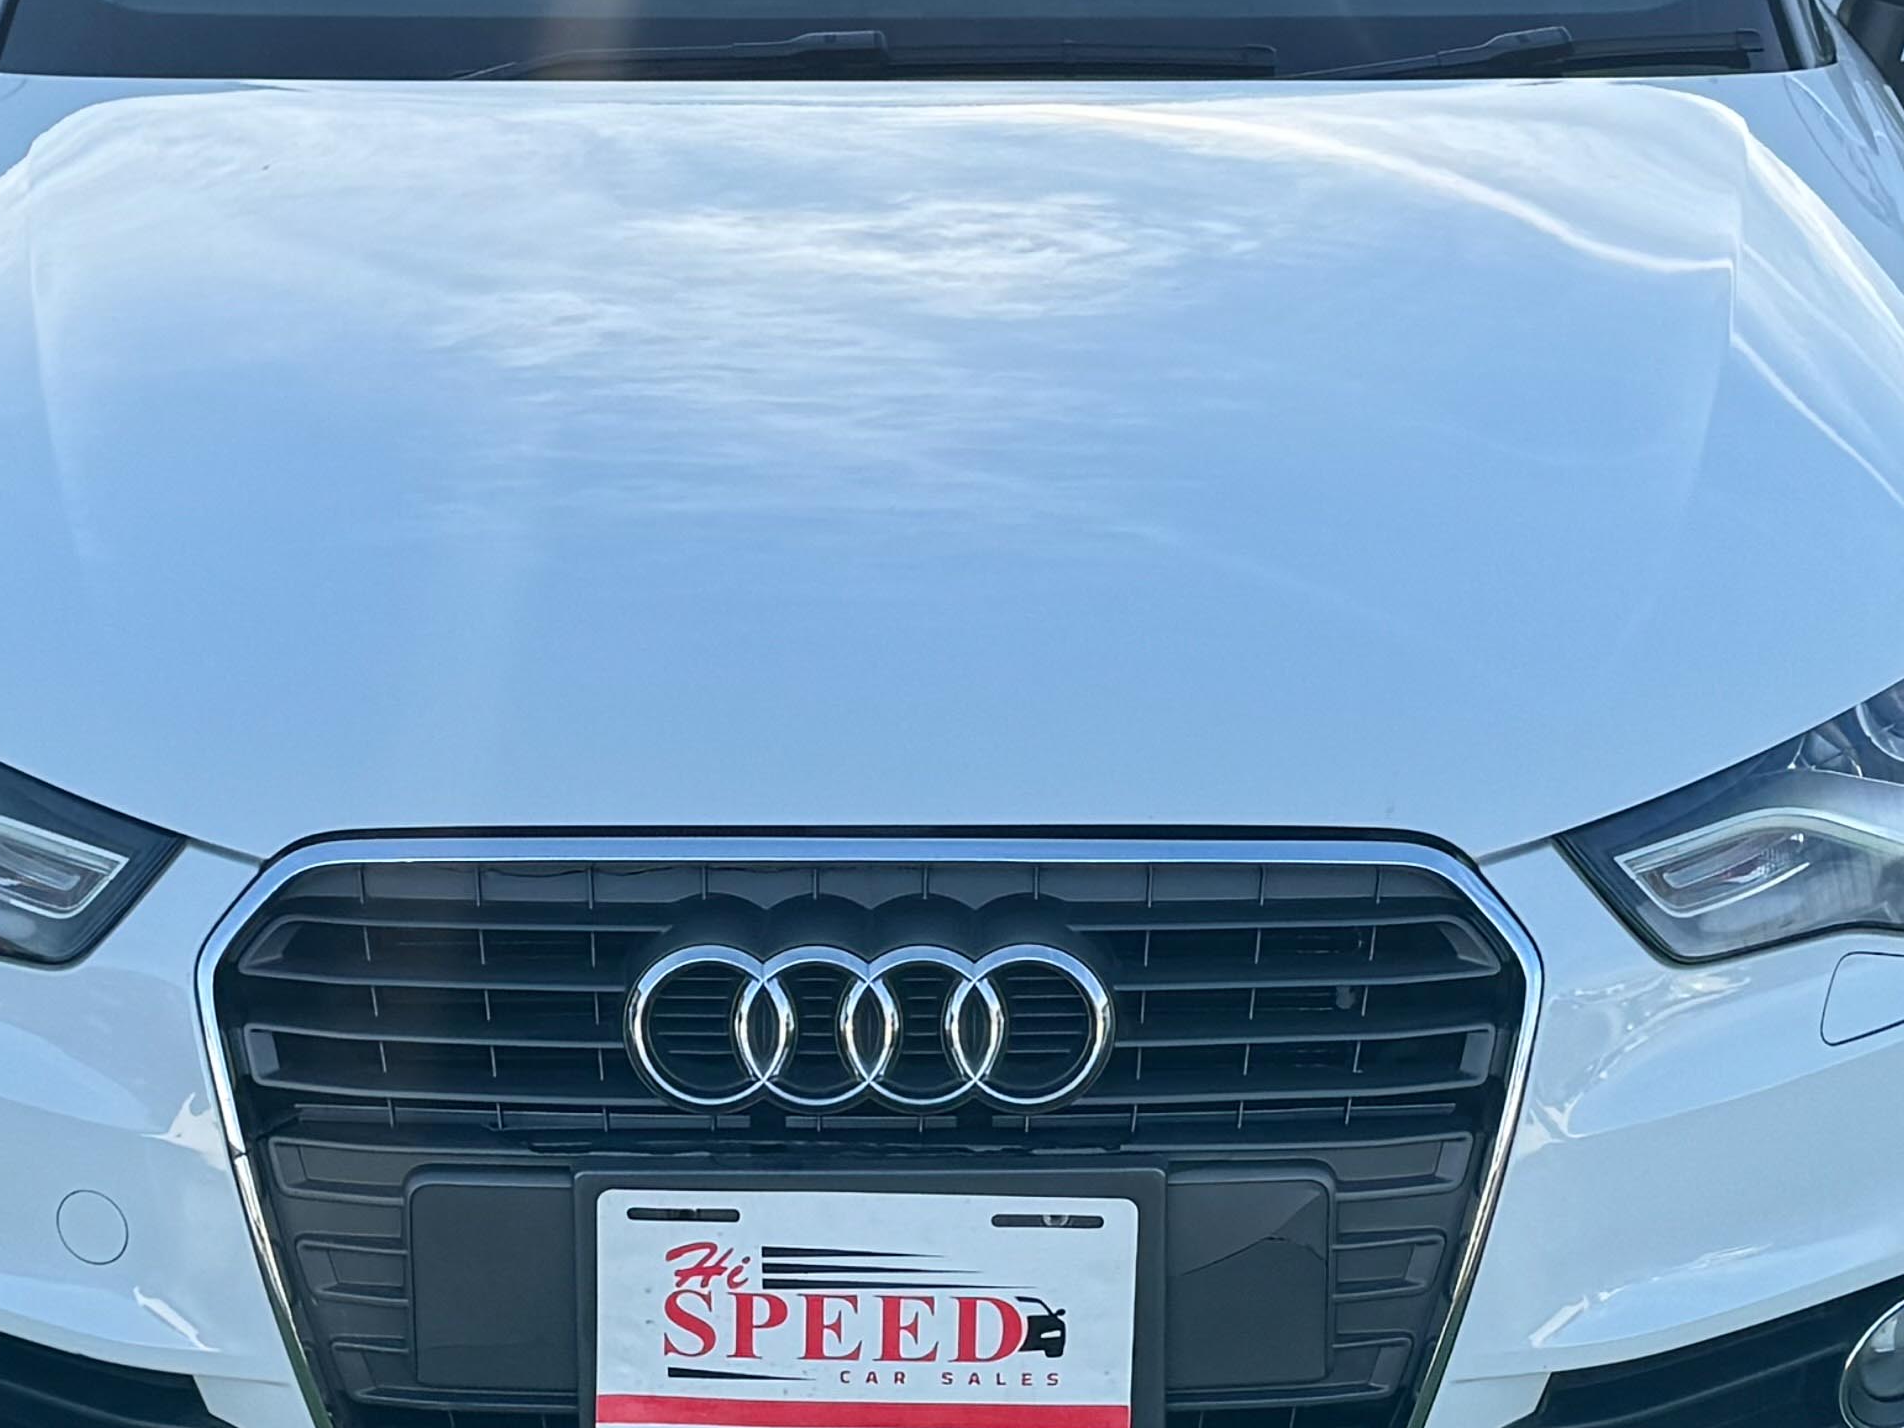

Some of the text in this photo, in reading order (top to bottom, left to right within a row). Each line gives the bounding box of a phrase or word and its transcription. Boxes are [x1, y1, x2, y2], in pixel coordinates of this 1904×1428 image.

[665, 1241, 751, 1289] Hi
[664, 1289, 1024, 1363] SPEED
[839, 1371, 1061, 1388] CAR SALES
